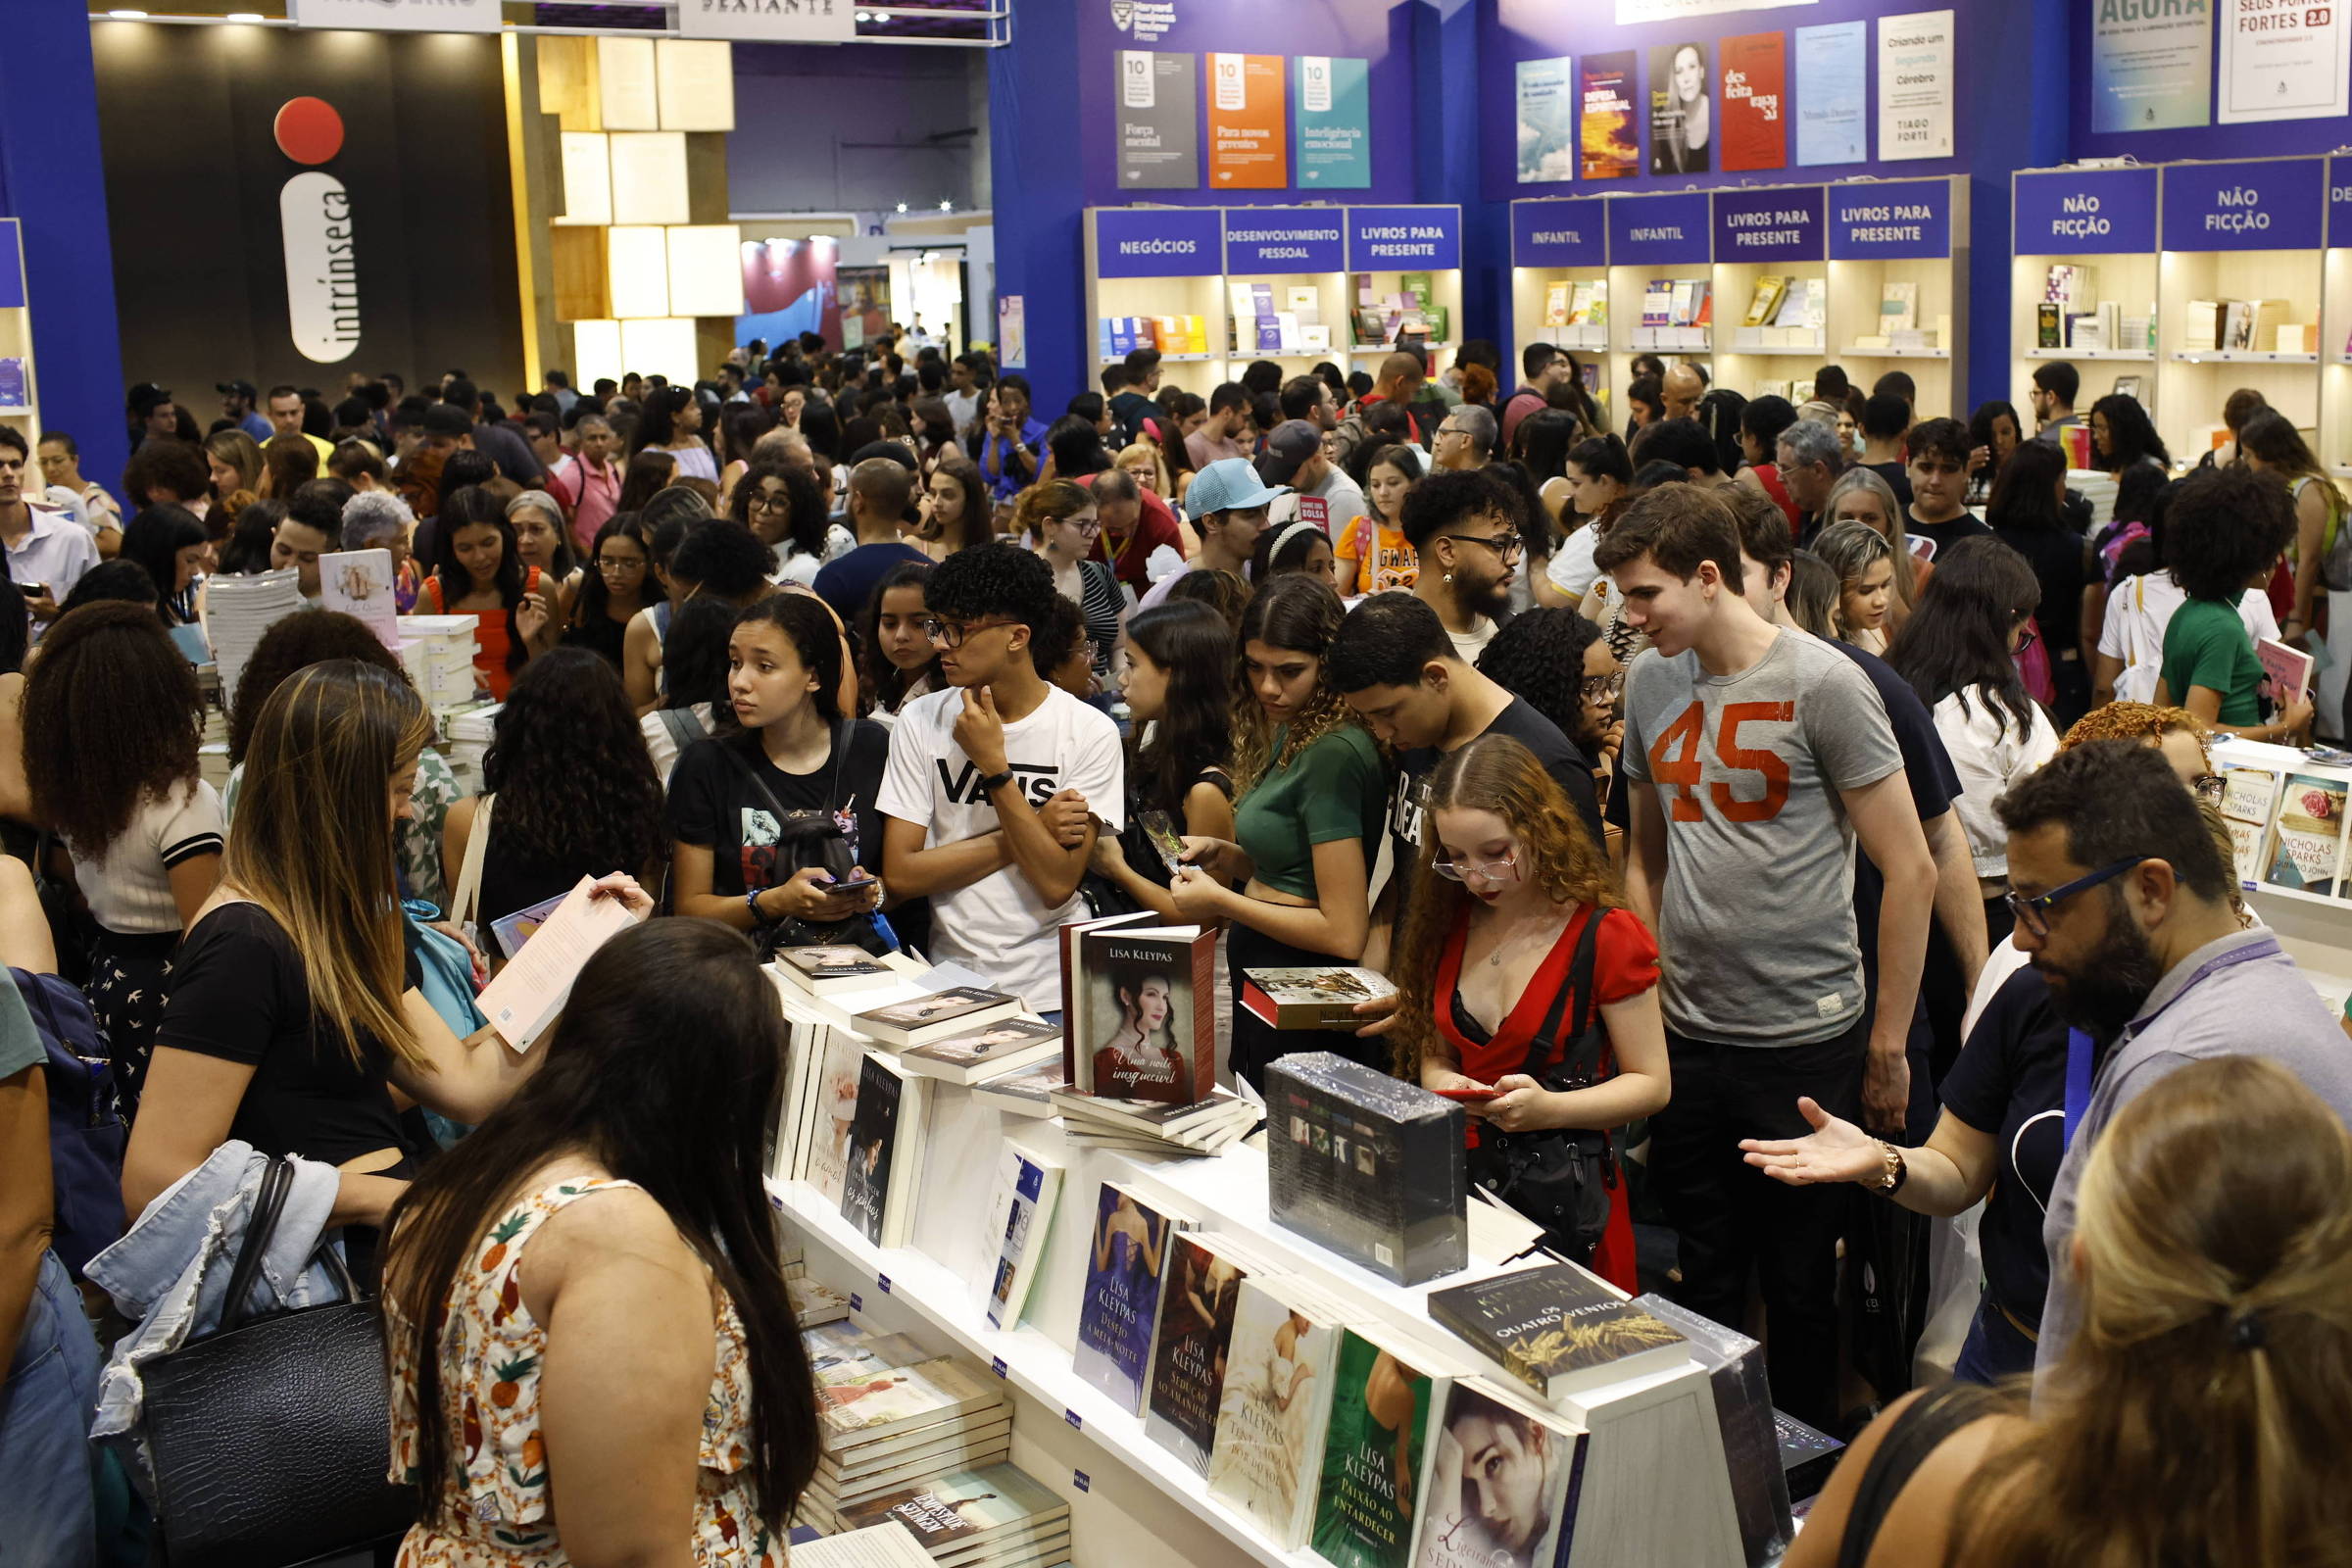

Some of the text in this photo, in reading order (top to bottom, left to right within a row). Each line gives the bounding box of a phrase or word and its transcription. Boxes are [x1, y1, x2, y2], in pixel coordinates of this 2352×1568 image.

[2239, 0, 2274, 13] SEUS
[2239, 10, 2329, 33] FORTES 2.0
[1887, 34, 1945, 49] Criando um
[1127, 60, 1146, 74] 10
[1219, 64, 1237, 78] 10
[1306, 66, 1324, 80] 10
[1896, 72, 1936, 85] Cérebro
[1897, 119, 1930, 129] TIAGO
[1897, 131, 1929, 142] FORTE
[2063, 193, 2100, 214] NÃO
[2217, 186, 2259, 207] NÃO
[1727, 209, 1810, 227] LIVROS PARA
[1840, 204, 1932, 223] LIVROS PARA
[2205, 209, 2271, 234] FICÇÃO
[1227, 229, 1340, 243] DESENVOLVIMENTO
[1361, 226, 1445, 241] LIVROS PARA
[1630, 226, 1684, 242] INFANTIL
[1850, 225, 1922, 243] PRESENTE
[2052, 216, 2111, 239] FICÇÃO
[1120, 238, 1197, 255] NEGÓCIOS
[1532, 230, 1582, 245] INFANTIL
[1736, 229, 1801, 247] PRESENTE
[1258, 247, 1309, 260] PESSOAL
[1370, 244, 1436, 258] PRESENTE
[318, 190, 361, 342] intrínseca
[1301, 509, 1326, 518] BOLSA
[1648, 700, 1795, 822] 45
[2230, 803, 2257, 816] SPARKS
[2279, 835, 2332, 856] NICHOLAS
[2285, 848, 2323, 864] SPARKS
[2308, 866, 2329, 876] JOHN
[1109, 948, 1174, 962] LISA KLEYPAS
[863, 1063, 875, 1080] LISA
[1109, 1276, 1129, 1302] LISA
[1099, 1287, 1137, 1325] KLEYPAS
[1541, 1304, 1561, 1316] OS
[1101, 1311, 1128, 1339] DESEJO
[1495, 1299, 1629, 1339] QUATRO VENTOS
[1185, 1334, 1205, 1363] LISA
[1171, 1346, 1213, 1388] KLEYPAS
[1156, 1380, 1169, 1395] AO
[1170, 1369, 1209, 1405] SEDUÇÃO
[1254, 1394, 1276, 1420] LISA
[1240, 1401, 1285, 1446] KLEYPAS
[1359, 1441, 1385, 1474] LISA
[1345, 1452, 1396, 1500] KLEYPAS
[1341, 1477, 1394, 1522] PAIXÃO AO
[1333, 1494, 1396, 1545] ENTARDECER
